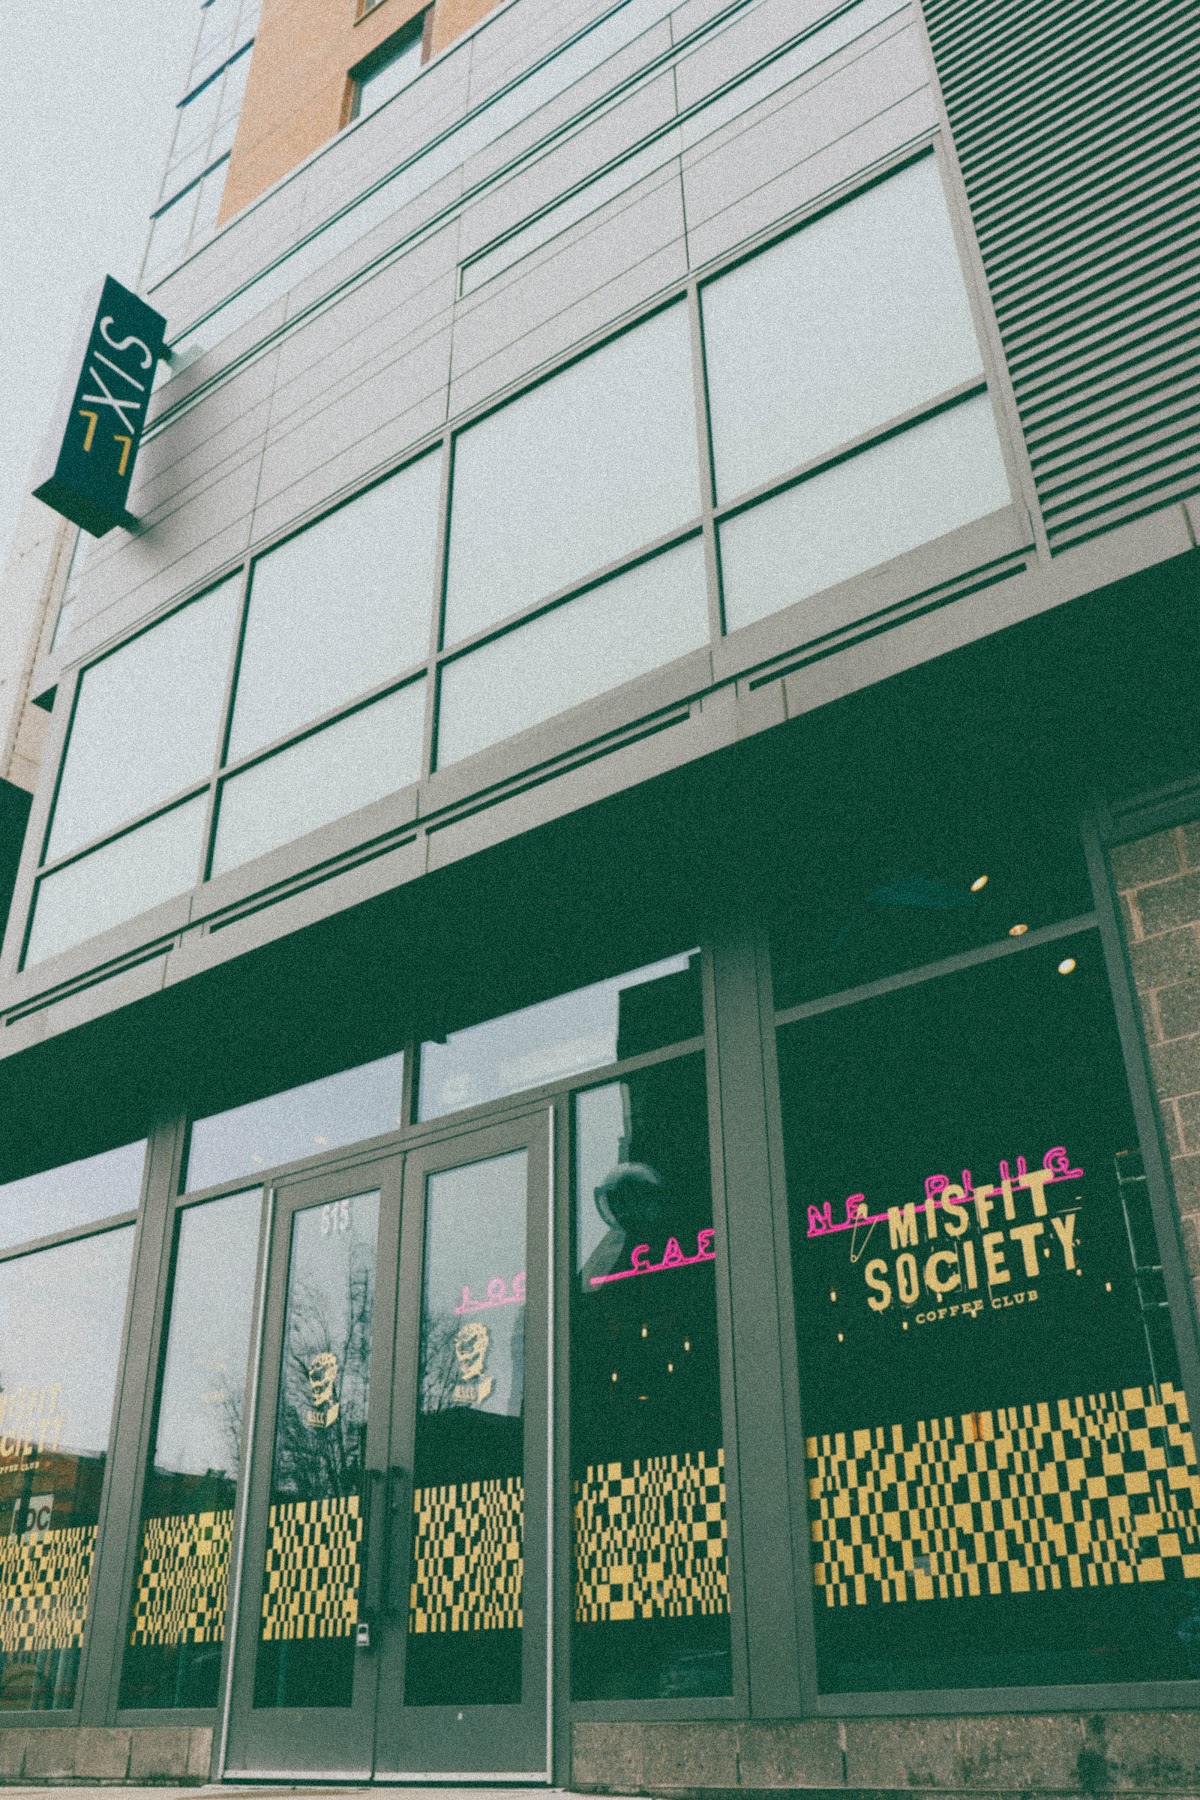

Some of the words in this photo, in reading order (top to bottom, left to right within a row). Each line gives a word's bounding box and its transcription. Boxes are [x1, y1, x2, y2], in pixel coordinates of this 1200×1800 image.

[888, 1169, 1054, 1250] MISFIT
[864, 1213, 1077, 1312] SOCIETY
[915, 1299, 984, 1325] COFFEE
[991, 1290, 1039, 1310] CLUB
